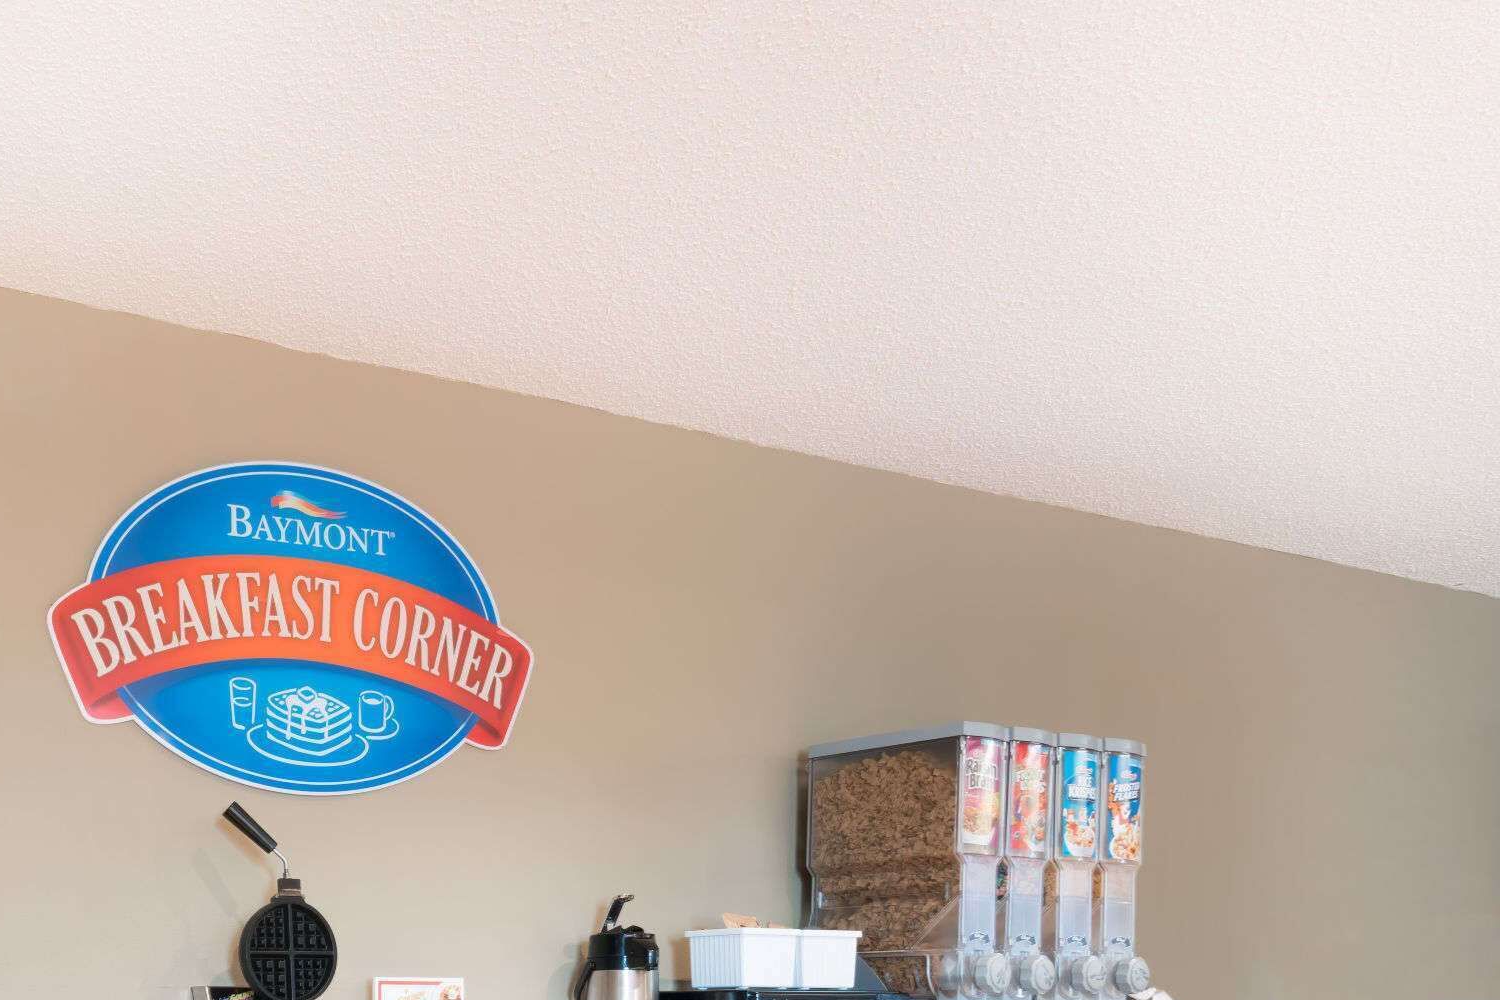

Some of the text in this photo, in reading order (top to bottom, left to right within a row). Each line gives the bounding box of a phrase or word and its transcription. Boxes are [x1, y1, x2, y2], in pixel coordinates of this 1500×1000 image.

[227, 503, 391, 556] BAYMONT
[71, 571, 514, 711] BREAKFAST CORNER
[965, 757, 997, 775] Rain
